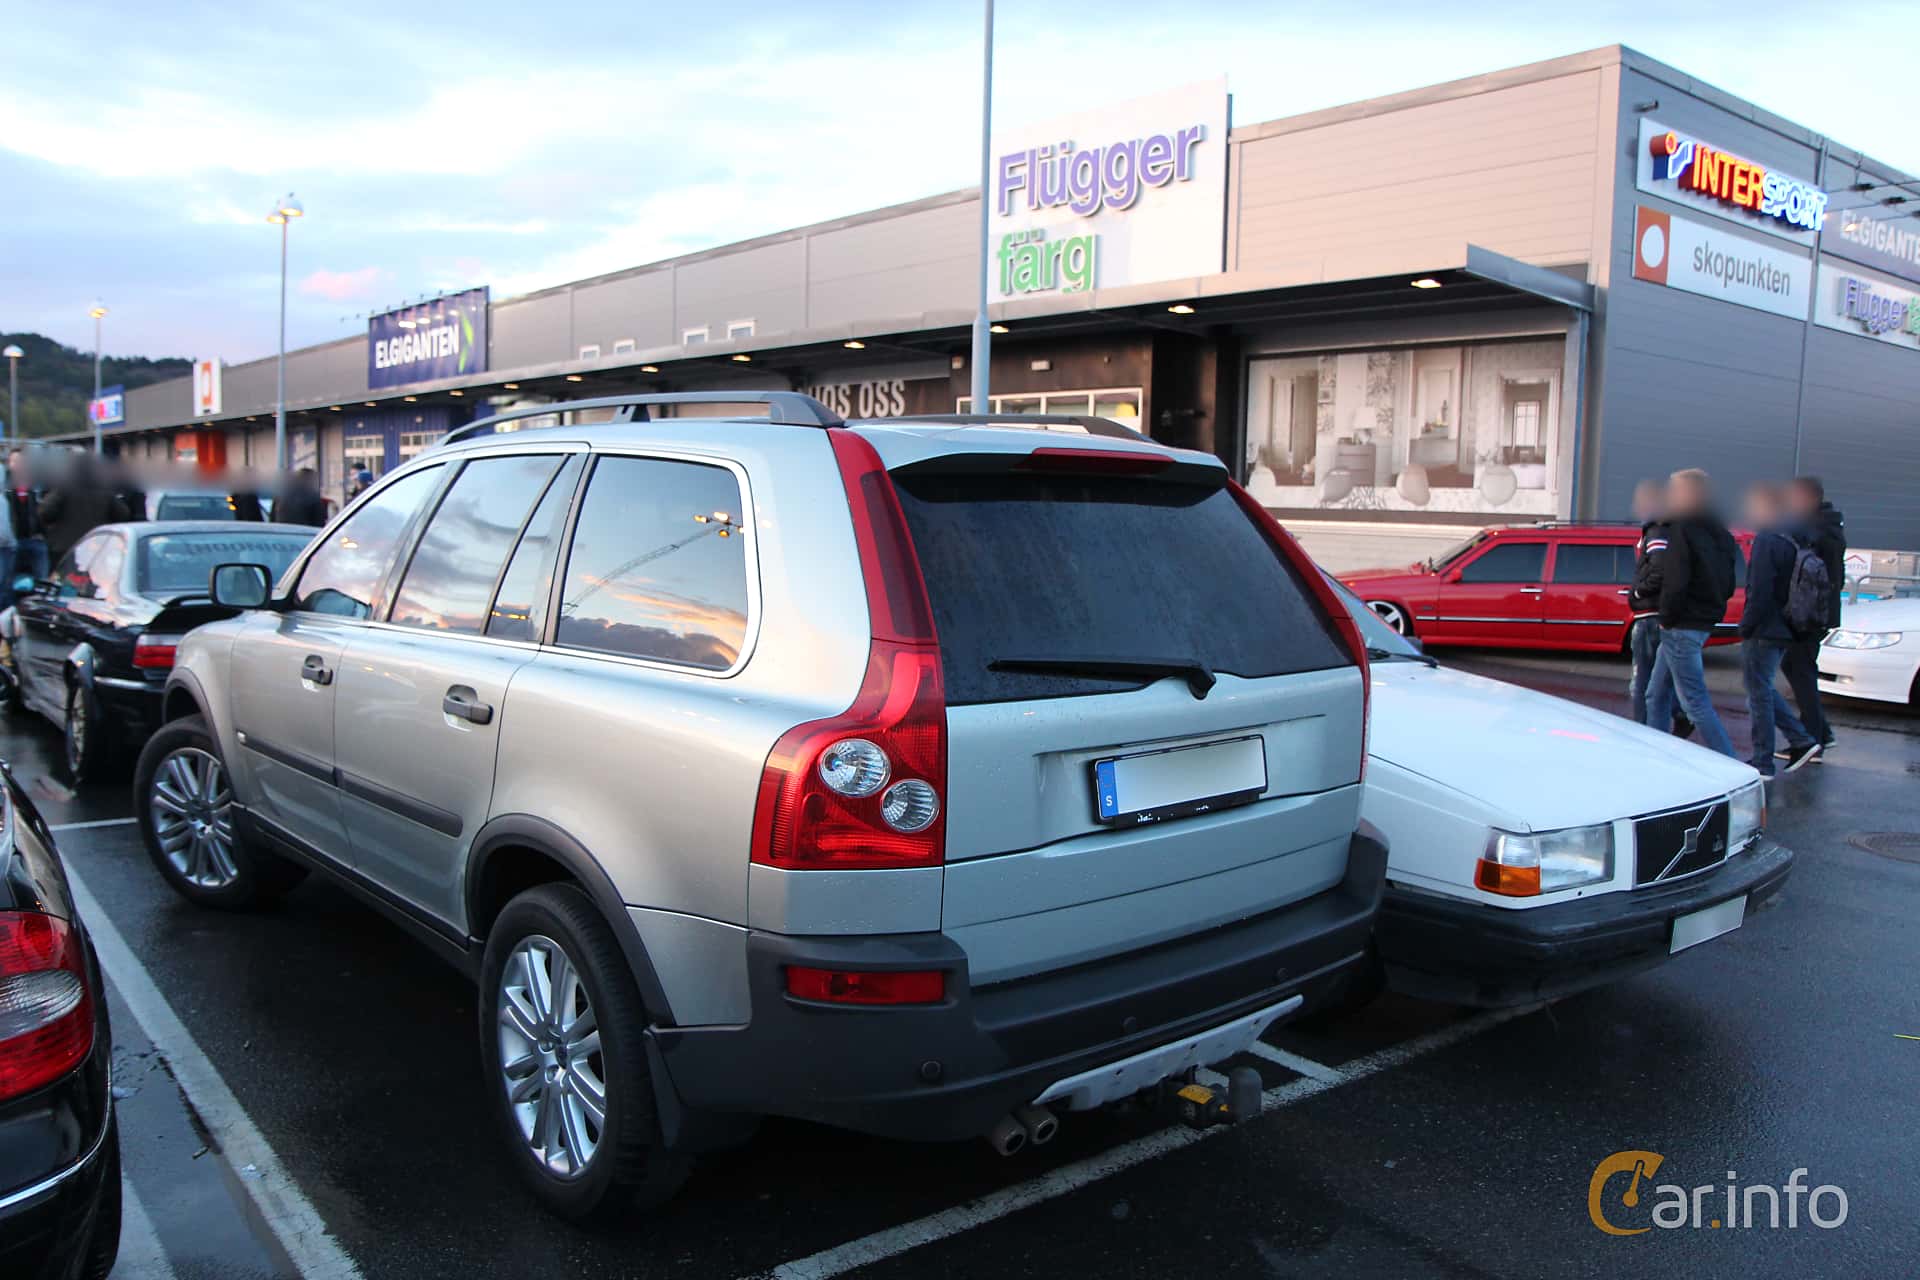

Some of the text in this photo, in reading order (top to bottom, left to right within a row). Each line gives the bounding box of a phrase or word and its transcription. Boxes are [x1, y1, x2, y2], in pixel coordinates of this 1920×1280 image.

[997, 125, 1203, 217] Flügger
[1684, 142, 1828, 231] INTERSPORT
[997, 229, 1099, 294] färg
[1692, 239, 1791, 297] skopunkten
[375, 323, 460, 369] ELGIGANTEN
[858, 379, 905, 418] OSS
[1105, 794, 1113, 807] S
